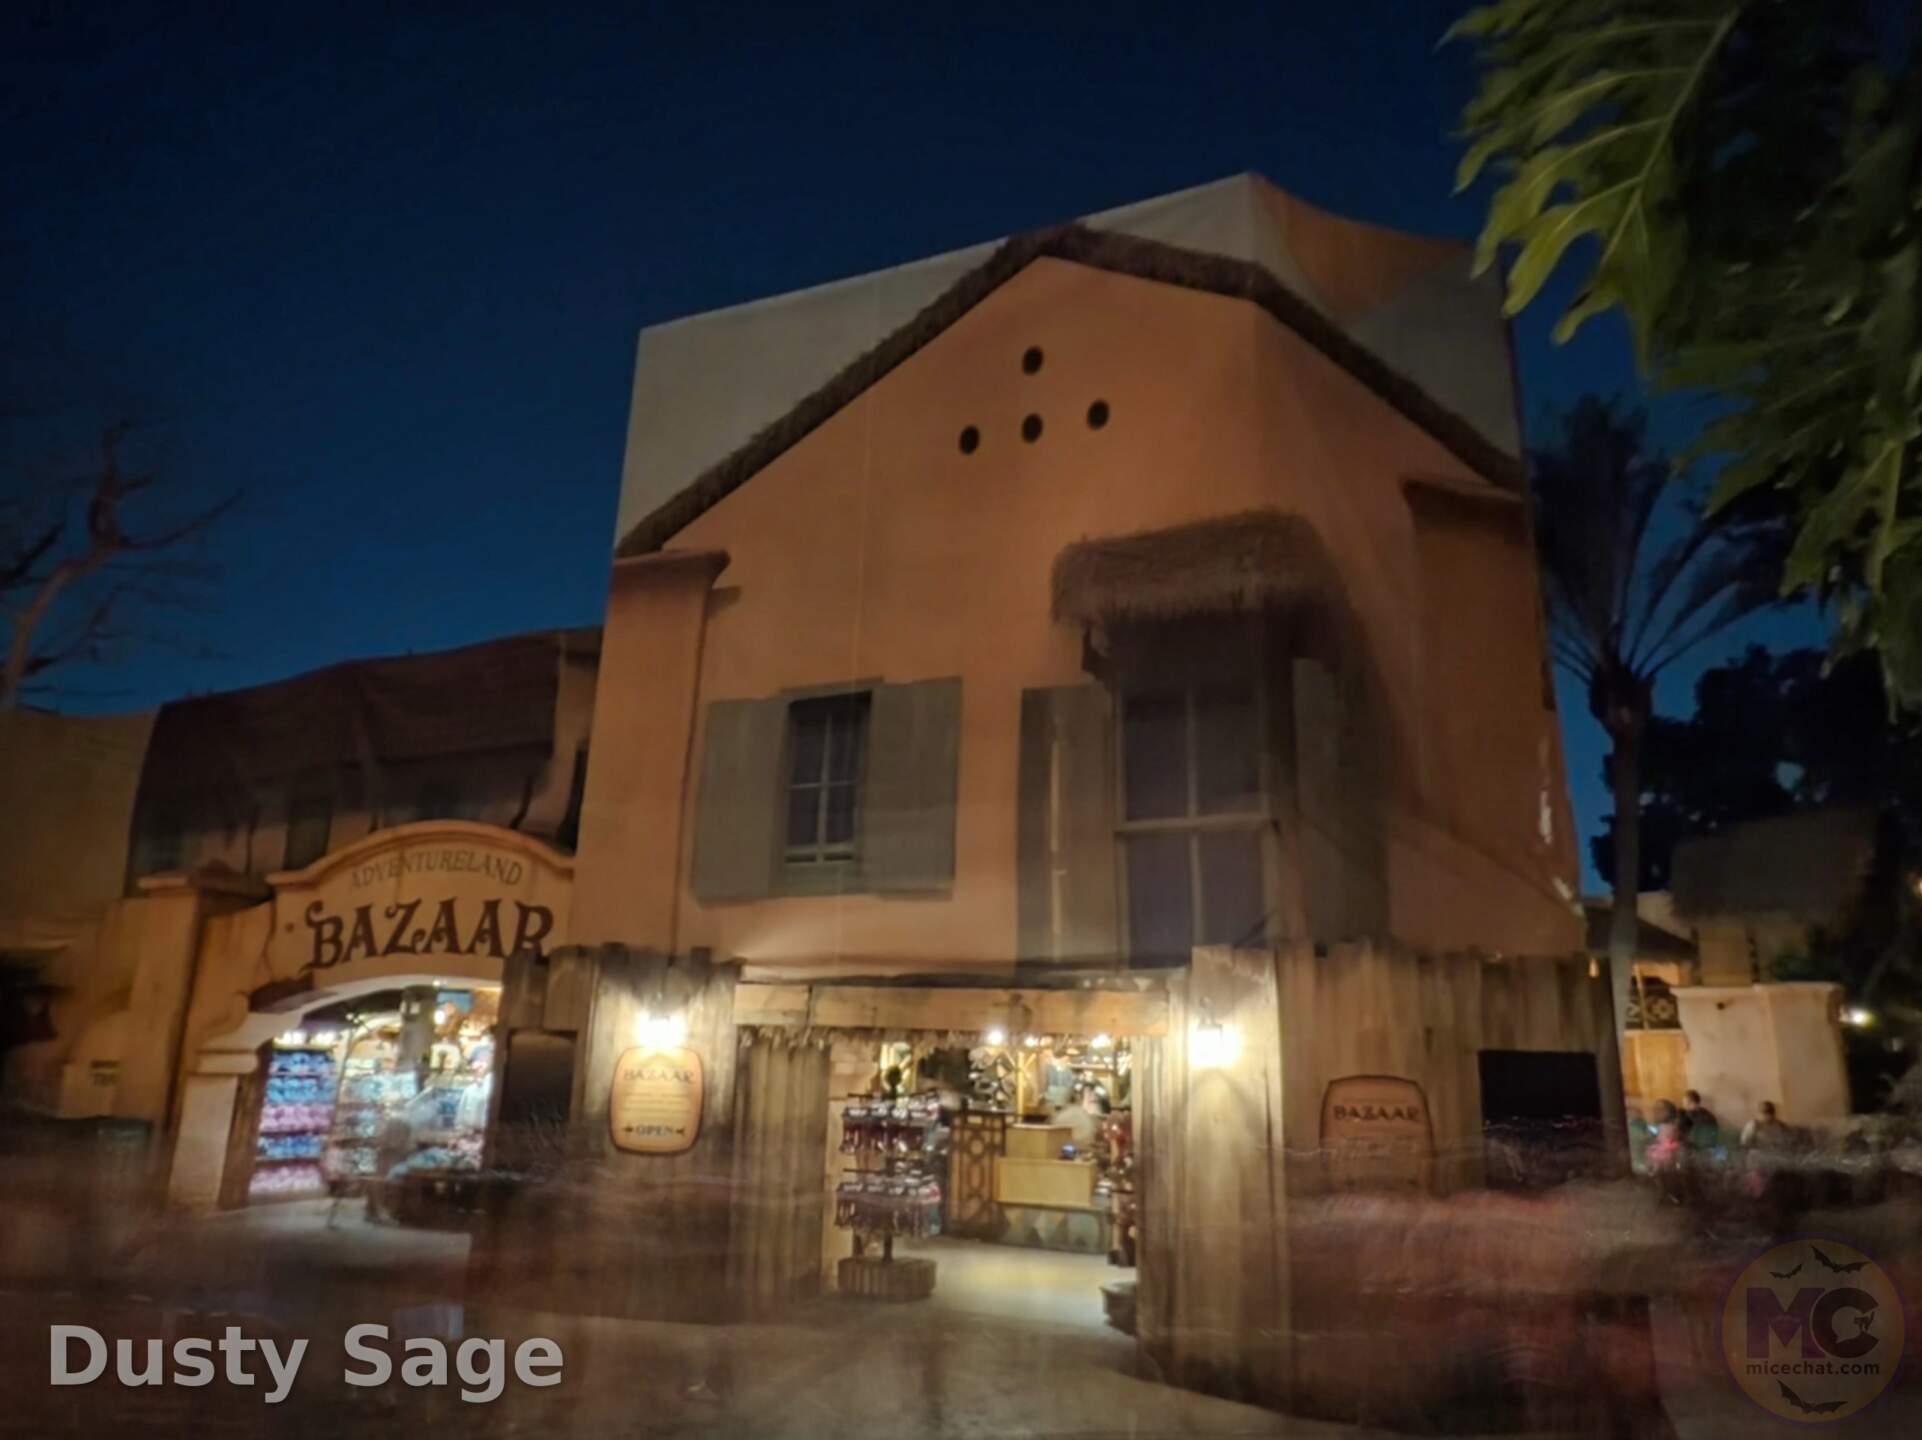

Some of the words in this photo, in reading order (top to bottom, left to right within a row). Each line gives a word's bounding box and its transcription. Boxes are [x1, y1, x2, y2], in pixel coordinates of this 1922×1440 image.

[349, 850, 522, 888] ADVENTURELAND
[301, 897, 554, 970] BAZAAR
[624, 1068, 695, 1084] BAZAAR
[1333, 1104, 1420, 1121] BAZAAR
[635, 1125, 673, 1136] OPEN
